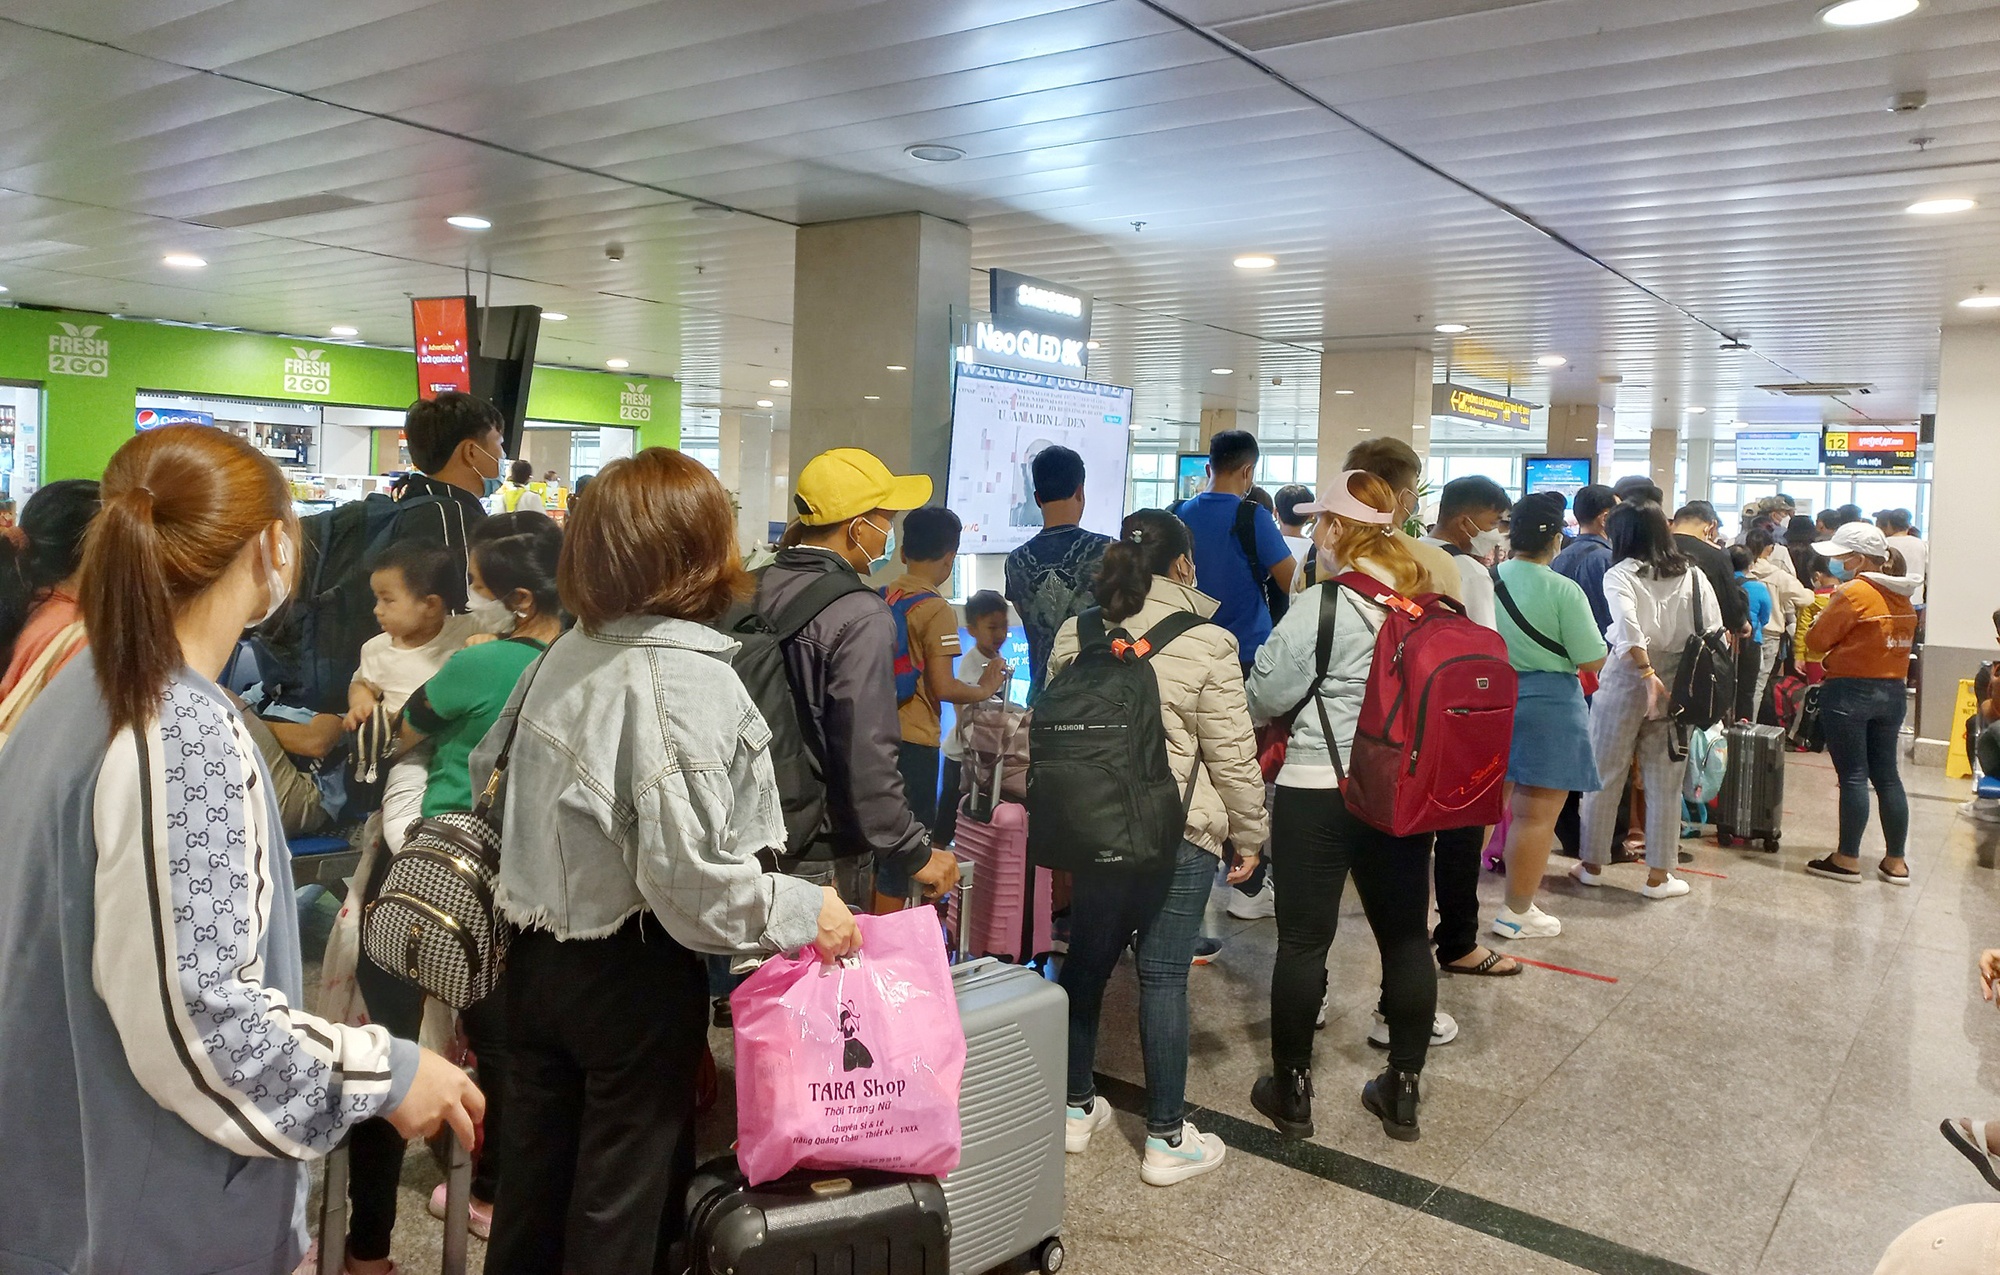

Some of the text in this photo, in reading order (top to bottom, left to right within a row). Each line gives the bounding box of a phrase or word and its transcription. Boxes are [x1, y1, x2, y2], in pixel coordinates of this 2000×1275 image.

[49, 335, 109, 356] FRESH
[977, 322, 1016, 356] Neo
[1017, 330, 1061, 363] QLED
[52, 356, 105, 374] 2 GO
[284, 358, 330, 377] FRESH
[287, 377, 328, 392] 2 GO
[620, 391, 651, 406] FRESH
[622, 407, 649, 419] 2 GO
[1036, 412, 1053, 426] BIN
[1829, 438, 1846, 449] 12
[1857, 458, 1868, 466] HÀ
[808, 1079, 906, 1101] TARA Shop
[848, 1104, 875, 1115] Trang
